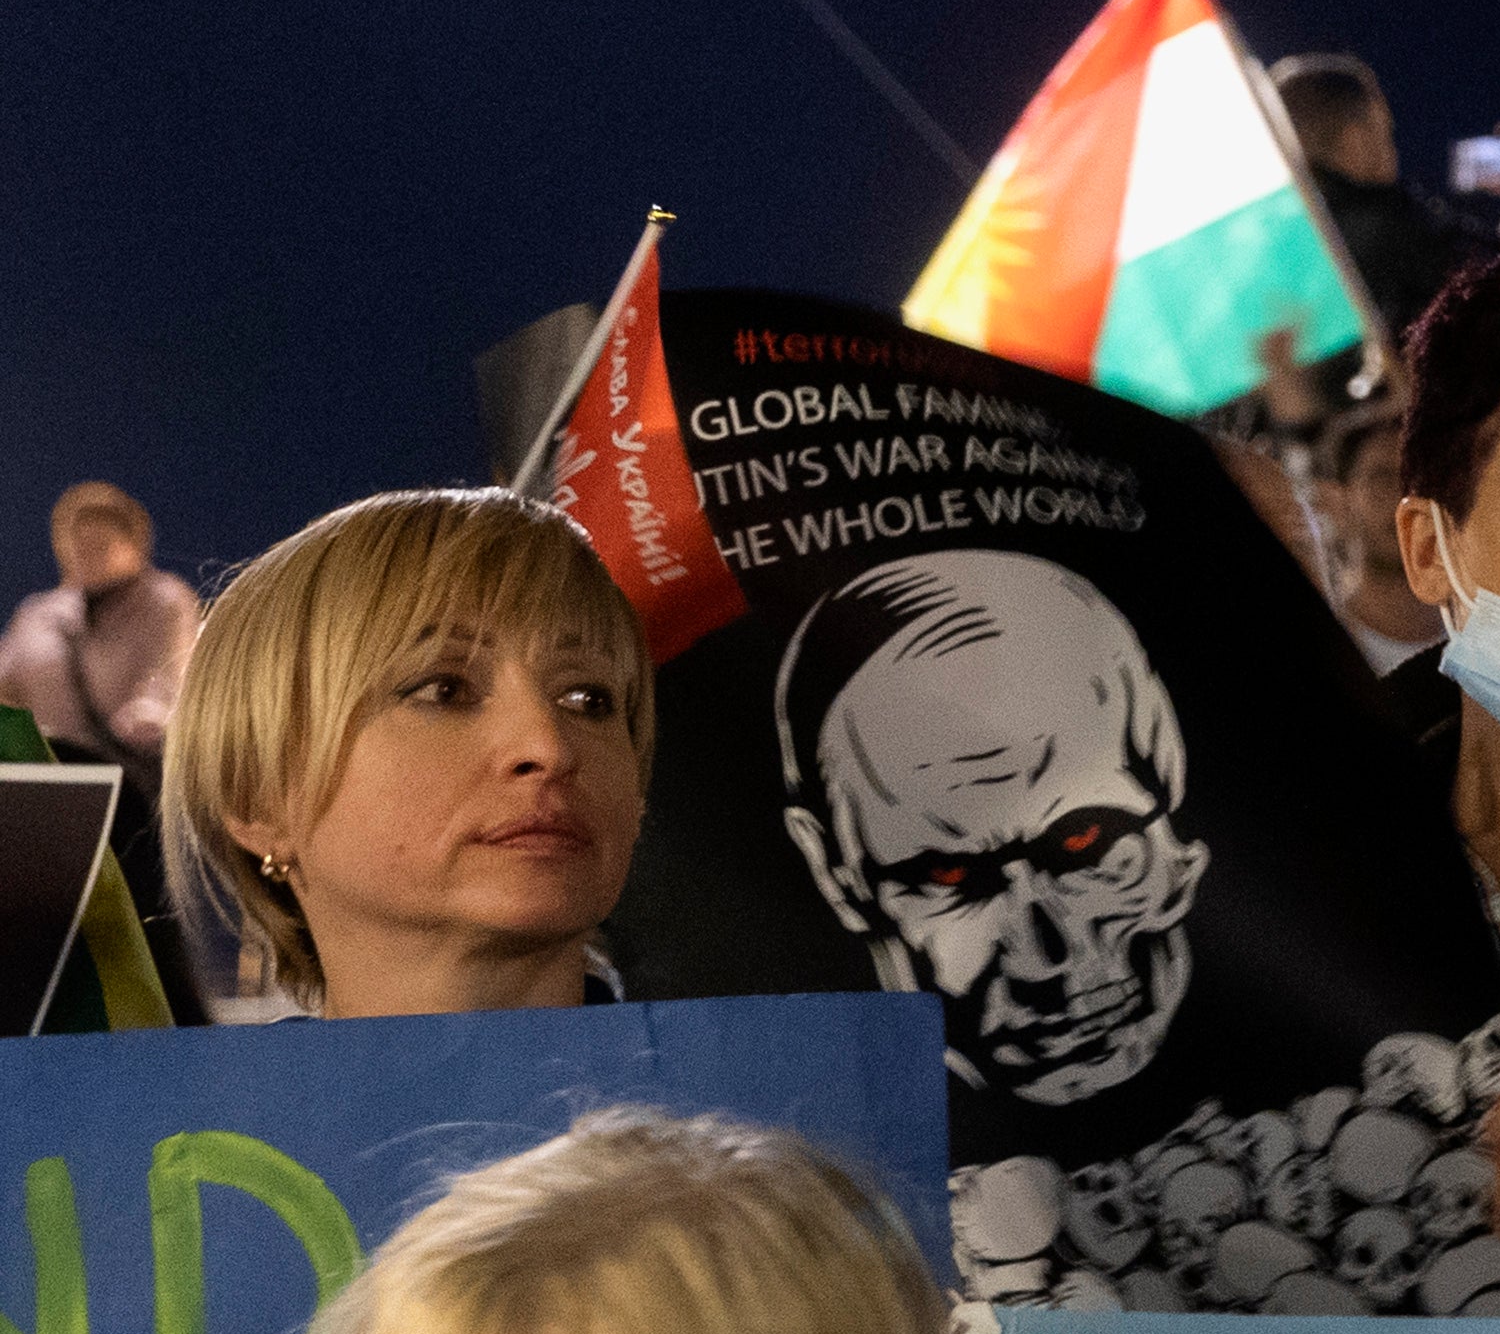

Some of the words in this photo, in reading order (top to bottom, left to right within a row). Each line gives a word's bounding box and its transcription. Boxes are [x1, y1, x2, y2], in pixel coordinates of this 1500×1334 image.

[690, 382, 891, 442] GLOBAL
[834, 431, 952, 481] WAR
[714, 522, 781, 570] HE
[781, 487, 972, 556] WHOLE
